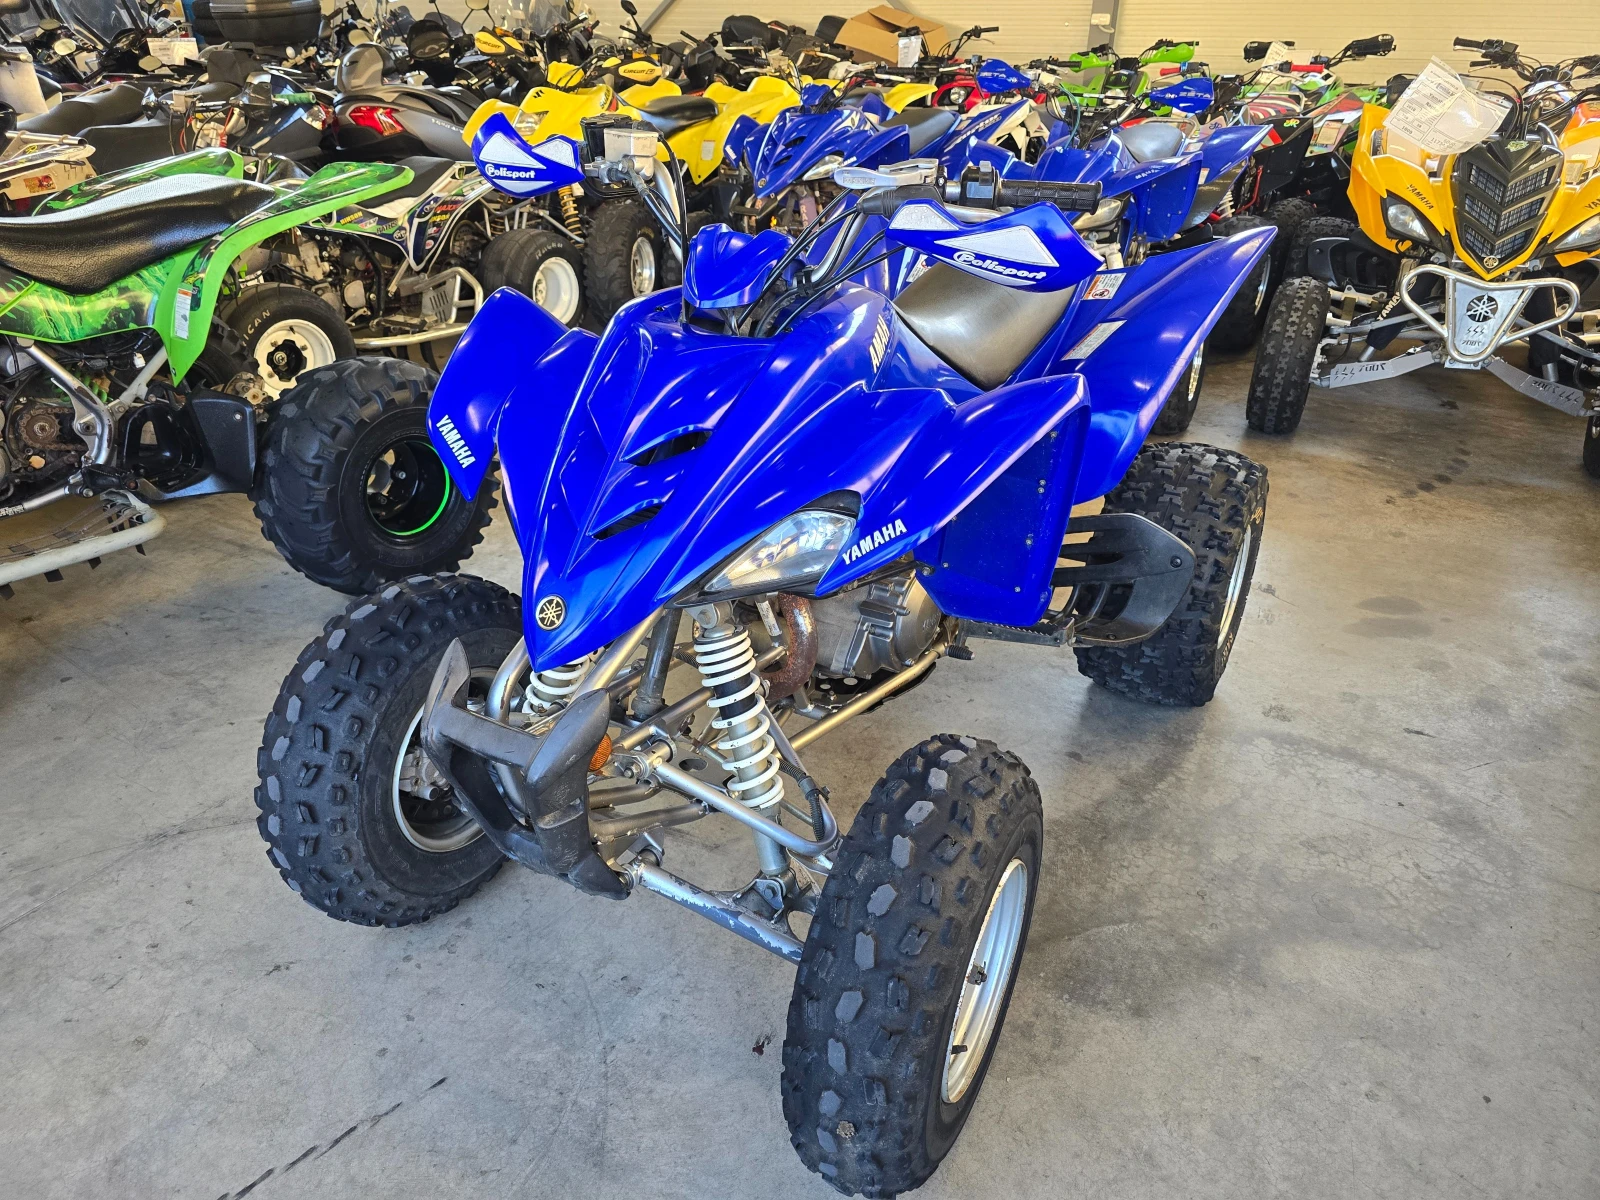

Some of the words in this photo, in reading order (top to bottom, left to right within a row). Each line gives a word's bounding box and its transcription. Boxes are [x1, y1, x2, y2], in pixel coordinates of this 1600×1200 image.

[485, 164, 536, 179] Polisport
[1406, 183, 1434, 210] YAMAHA
[953, 250, 1047, 280] Polisport
[436, 414, 476, 469] YAMAHA
[842, 518, 908, 565] YAMAHA
